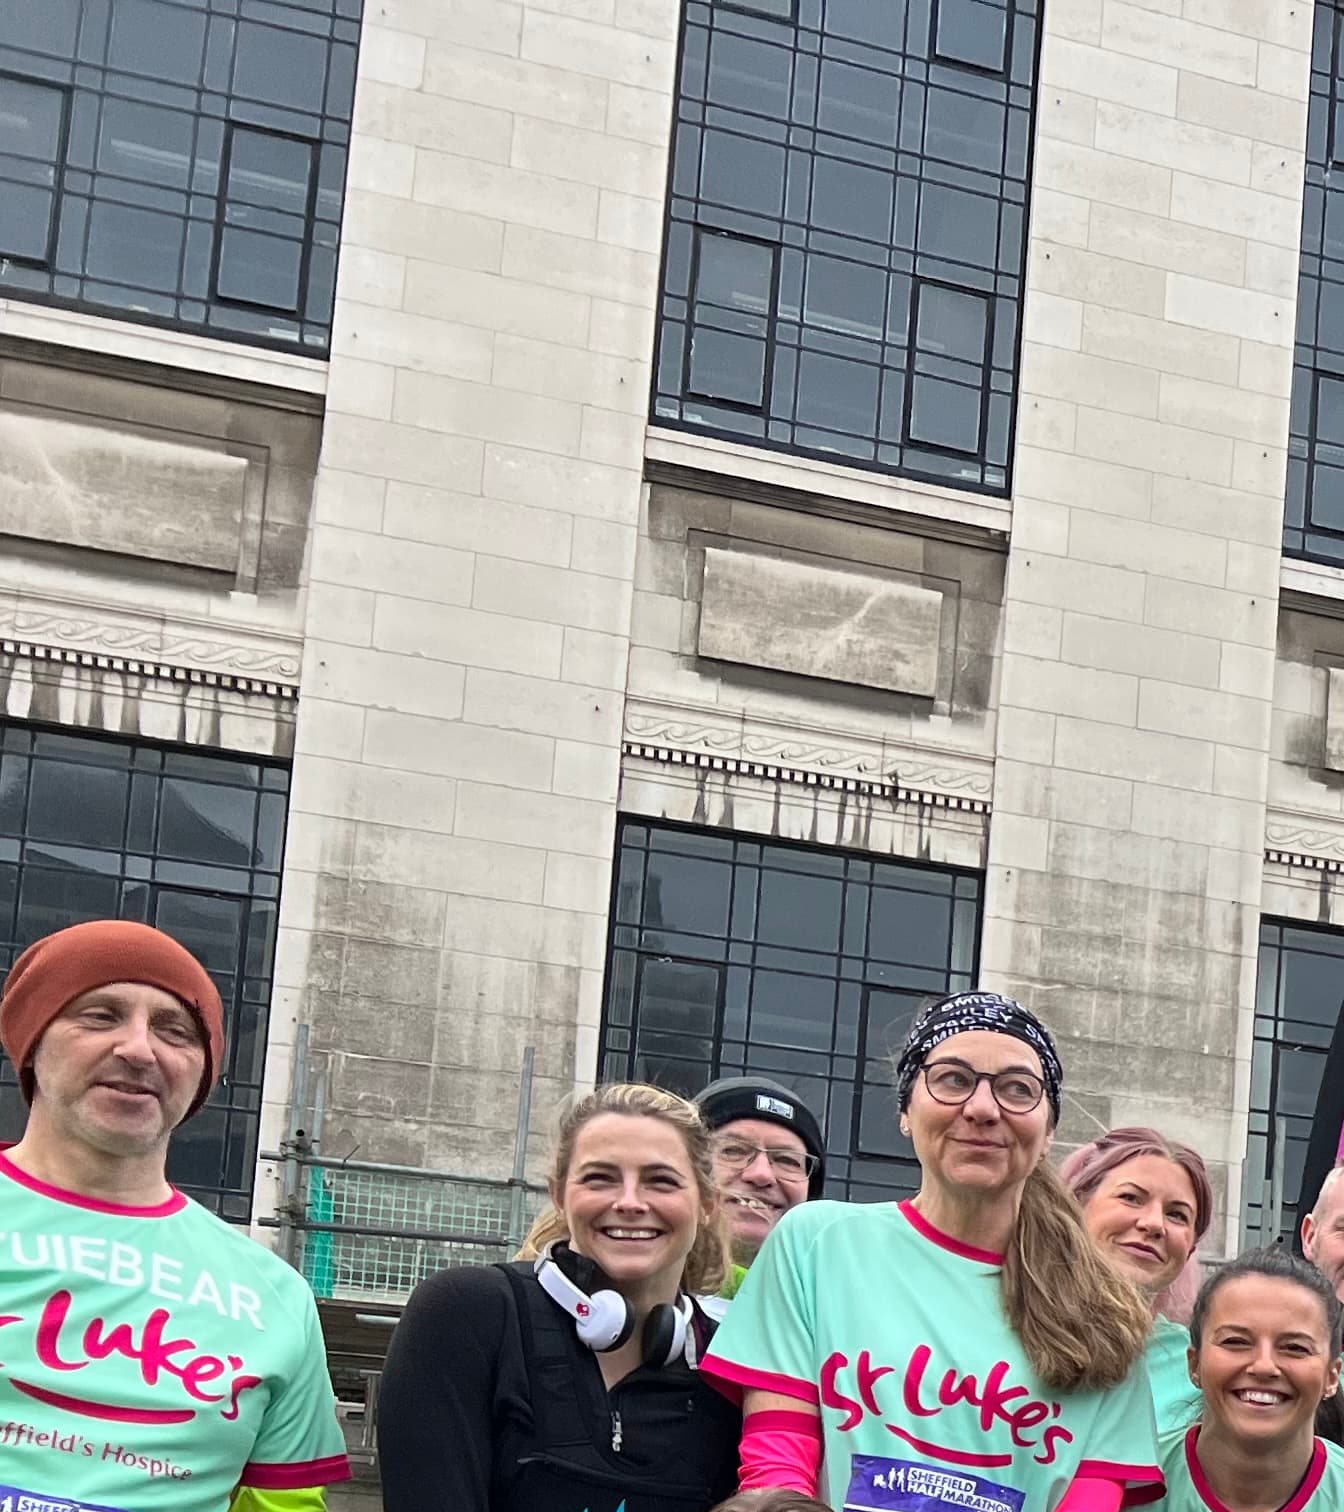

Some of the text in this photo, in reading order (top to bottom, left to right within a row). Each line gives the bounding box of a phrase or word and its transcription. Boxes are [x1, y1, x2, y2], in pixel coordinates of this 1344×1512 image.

[0, 1231, 265, 1331] UIEBEAR
[36, 1290, 263, 1420] Luke's
[903, 1344, 1073, 1464] Luke's
[102, 1442, 193, 1480] Hospice
[907, 1481, 942, 1498] HALF
[910, 1469, 974, 1493] SHEFFIELD
